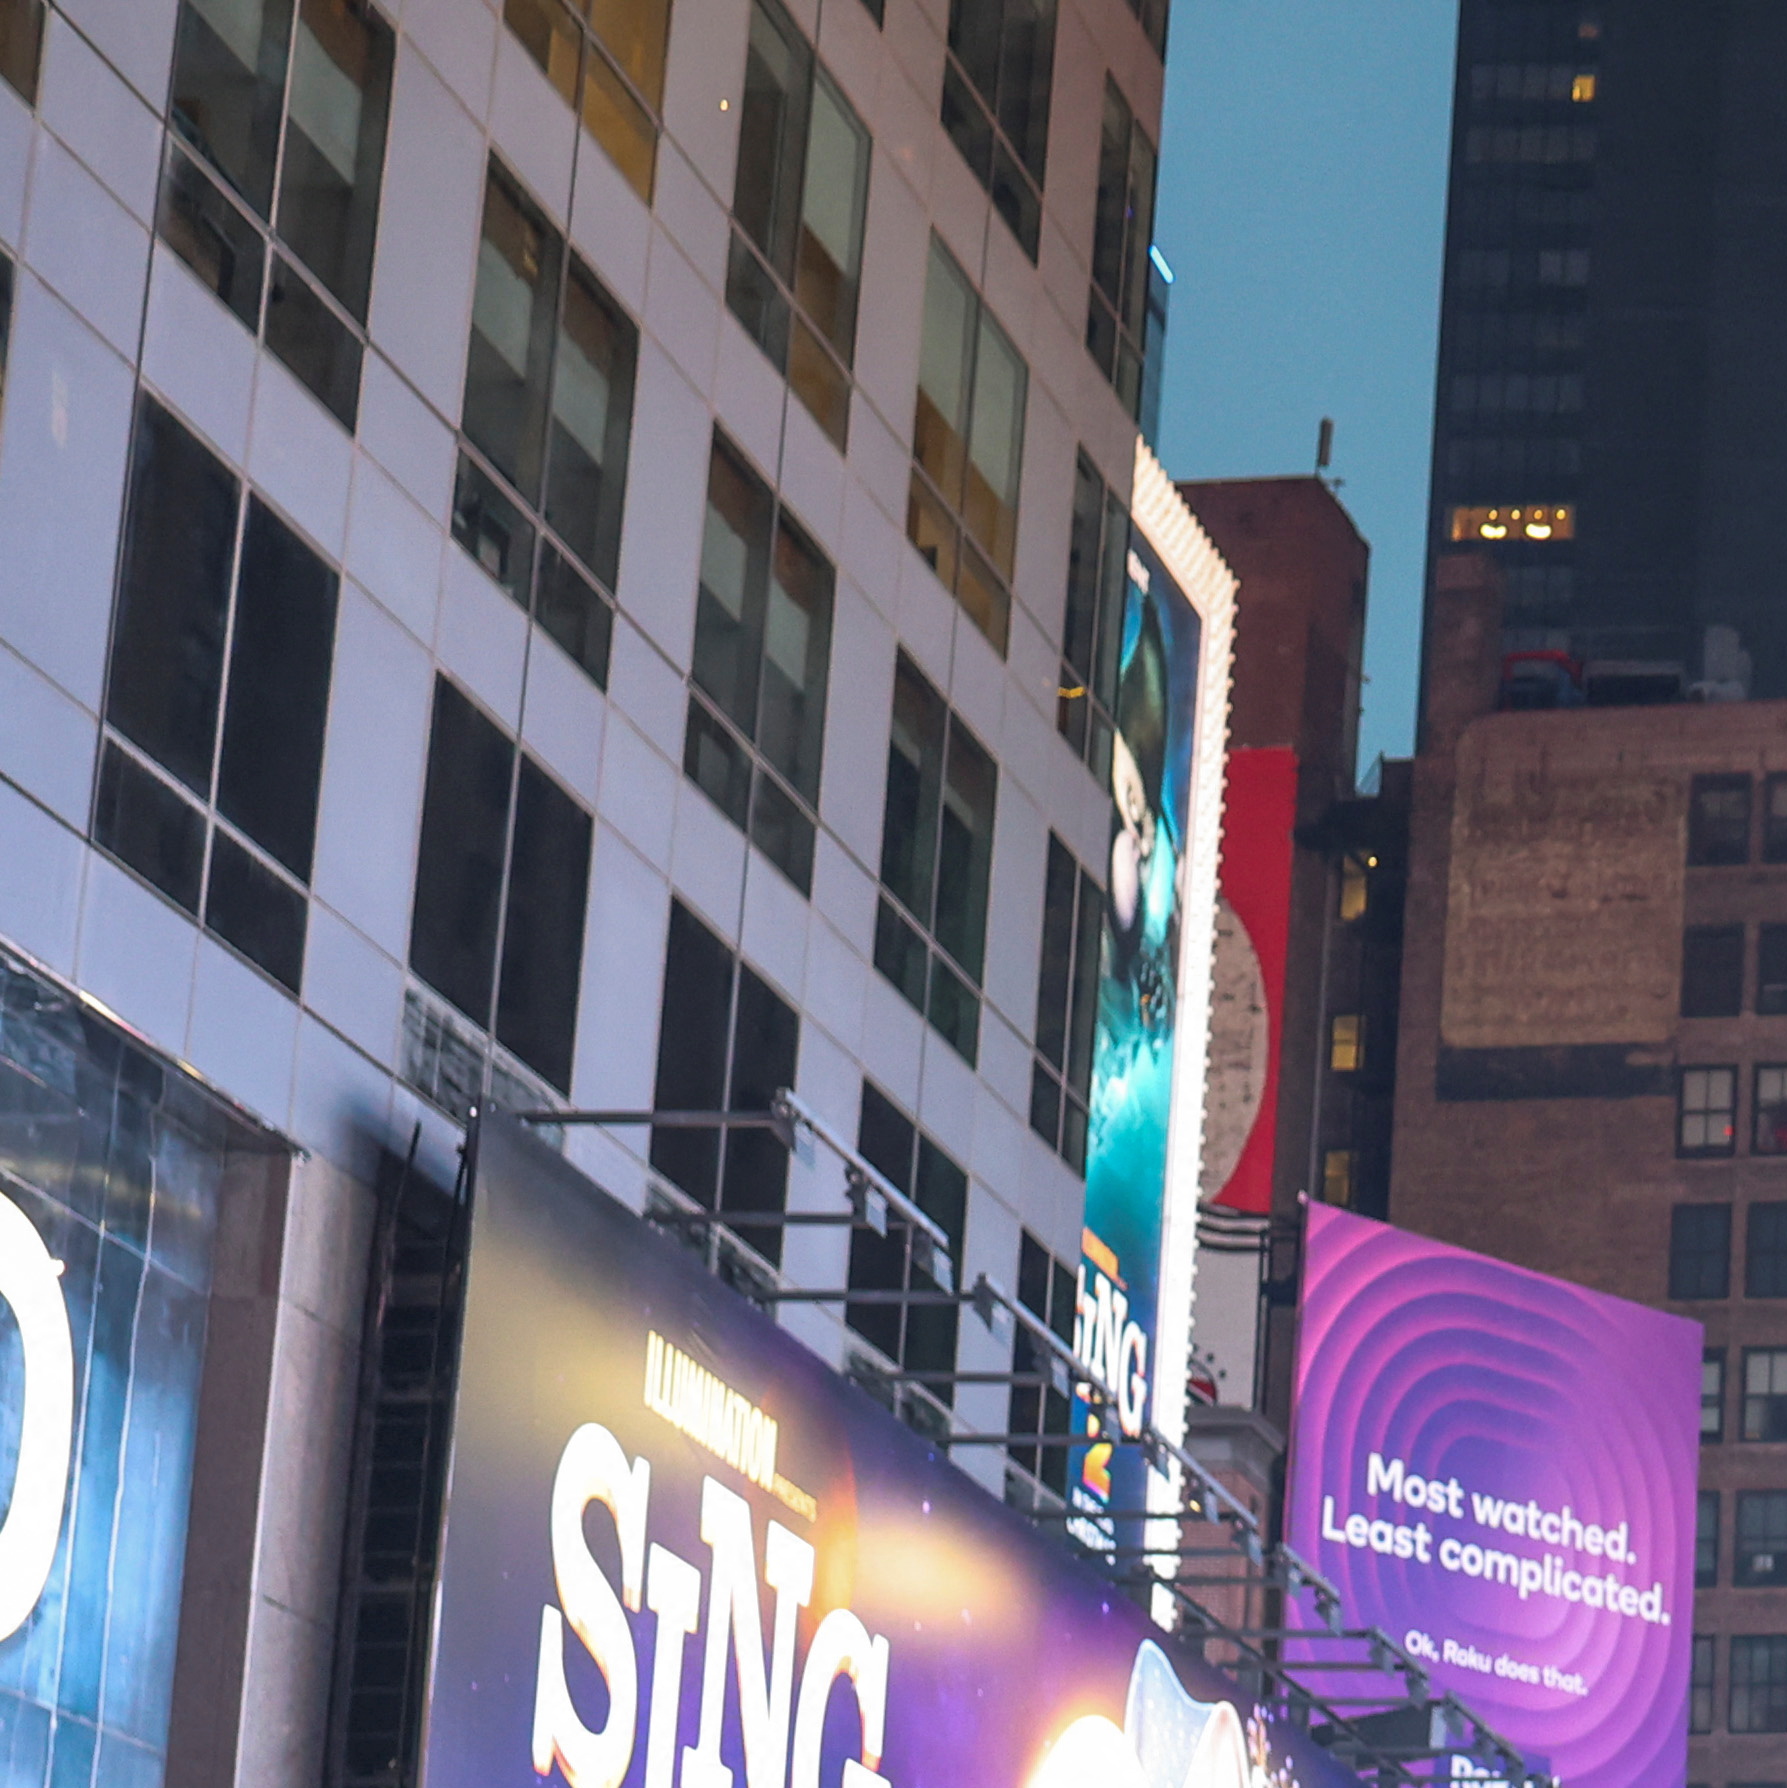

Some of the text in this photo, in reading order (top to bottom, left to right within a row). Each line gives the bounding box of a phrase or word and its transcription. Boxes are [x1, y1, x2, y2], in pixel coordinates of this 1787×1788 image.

[1322, 1495, 1671, 1626] Least complicated.
[1367, 1452, 1637, 1565] Most watched.
[1404, 1629, 1588, 1697] Ok, Roku does that.
